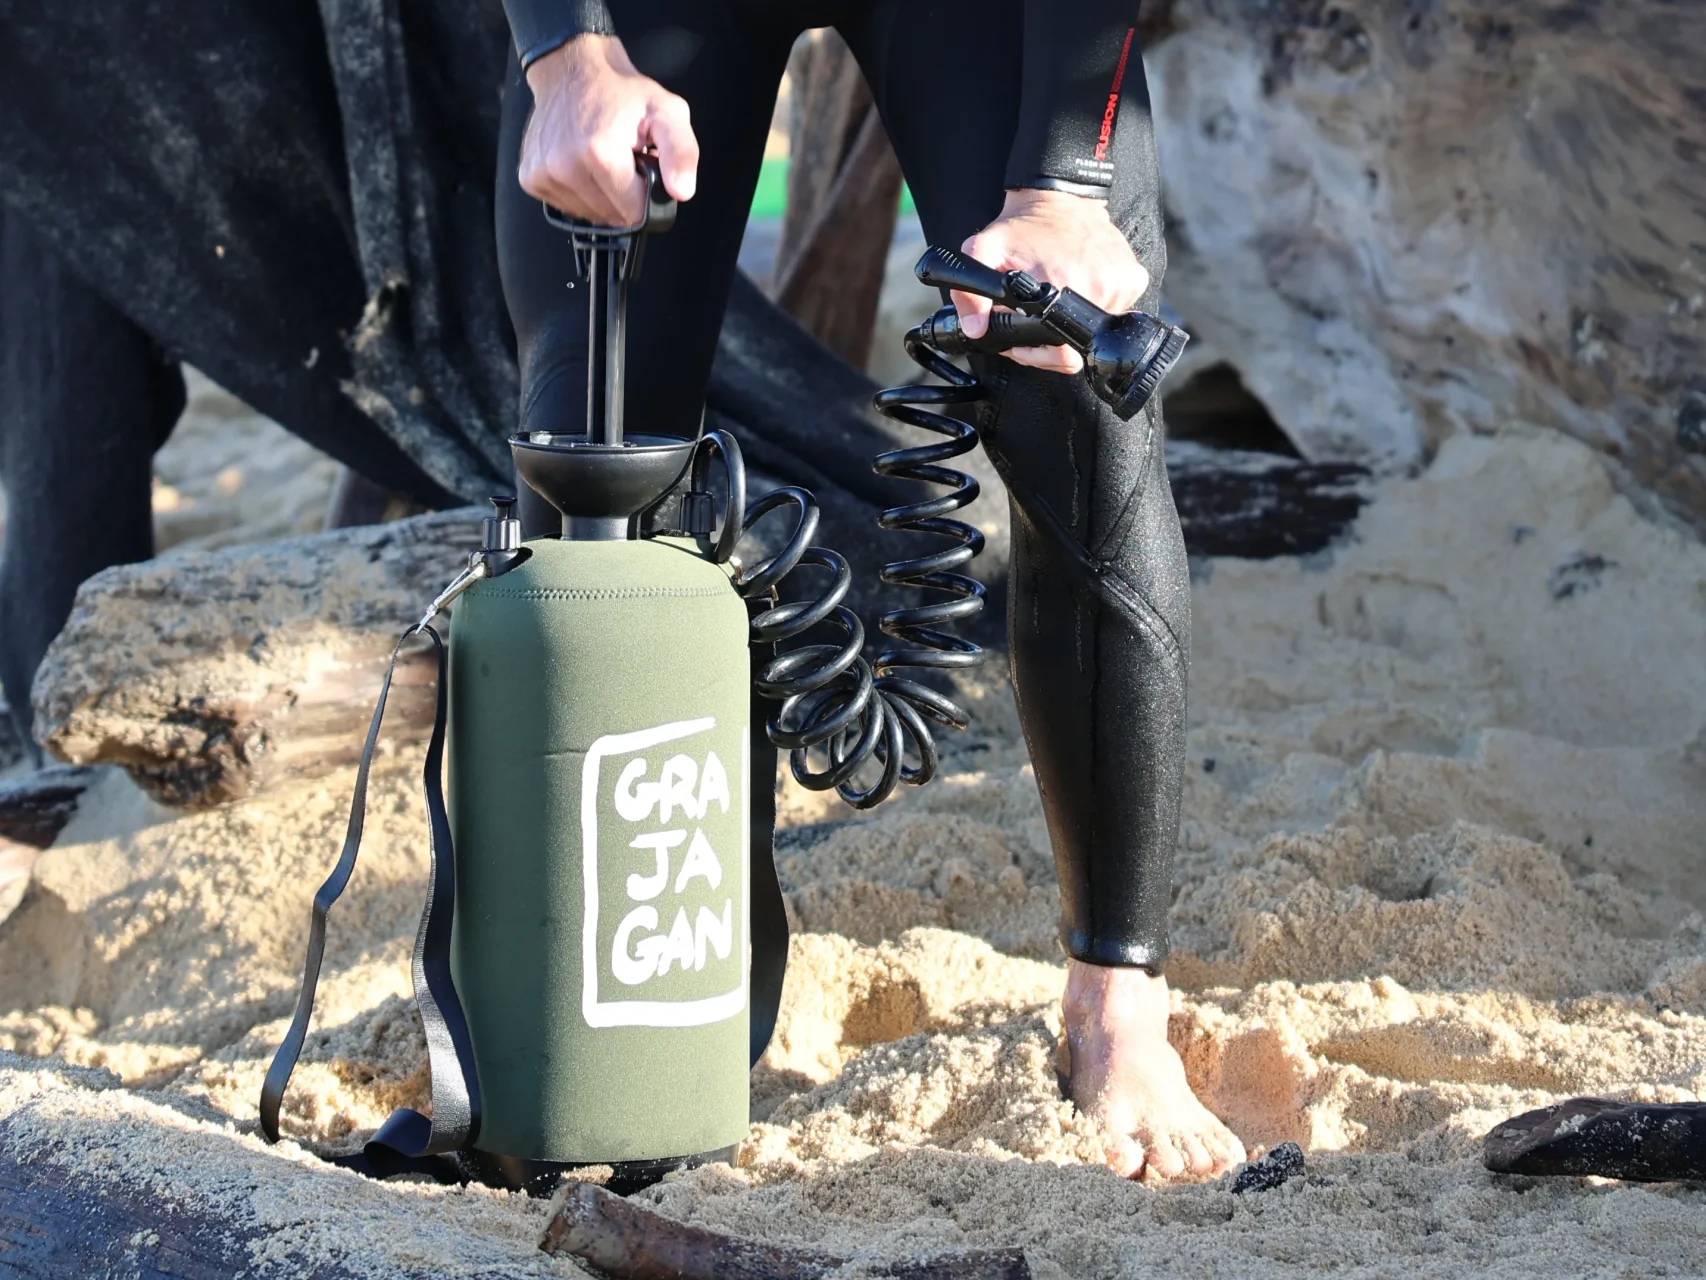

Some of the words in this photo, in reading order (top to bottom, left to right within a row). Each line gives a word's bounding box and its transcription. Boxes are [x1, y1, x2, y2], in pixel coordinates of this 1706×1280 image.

[1094, 94, 1118, 160] FUSION
[614, 750, 730, 824] GRA
[626, 826, 723, 901] JA
[612, 897, 732, 986] GAN
